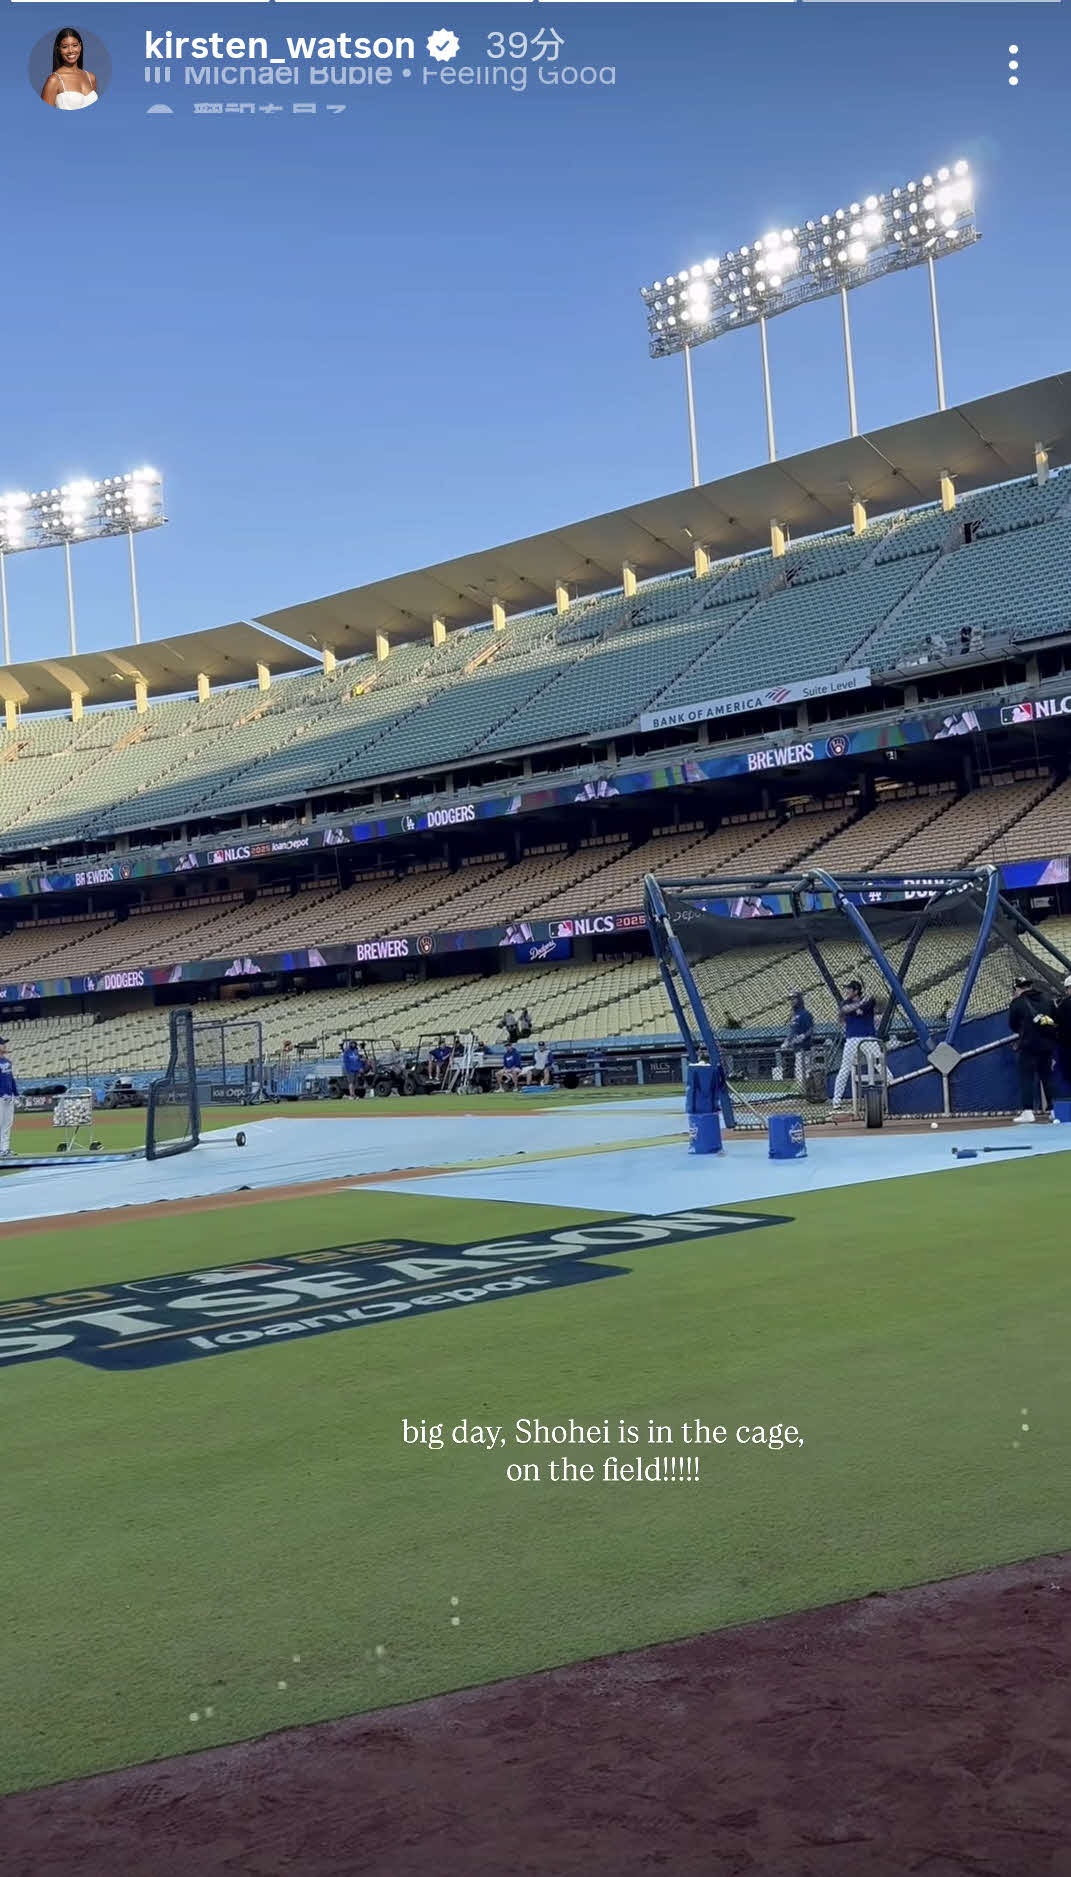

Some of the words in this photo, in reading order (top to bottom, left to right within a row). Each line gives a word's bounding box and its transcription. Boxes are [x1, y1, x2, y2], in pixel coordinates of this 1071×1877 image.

[652, 714, 685, 729] BANK
[688, 710, 704, 721] OF
[706, 697, 763, 718] AMERICA
[802, 686, 828, 698] Suite
[830, 678, 857, 692] Level
[748, 742, 815, 772] BREWERS
[427, 804, 476, 828] DODGERS
[224, 845, 250, 862] NLCS
[75, 868, 114, 887] BREWERS
[574, 915, 614, 936] NLCS
[616, 914, 646, 928] 2025
[357, 939, 409, 962] BREWERS
[104, 970, 144, 990] DODGERS
